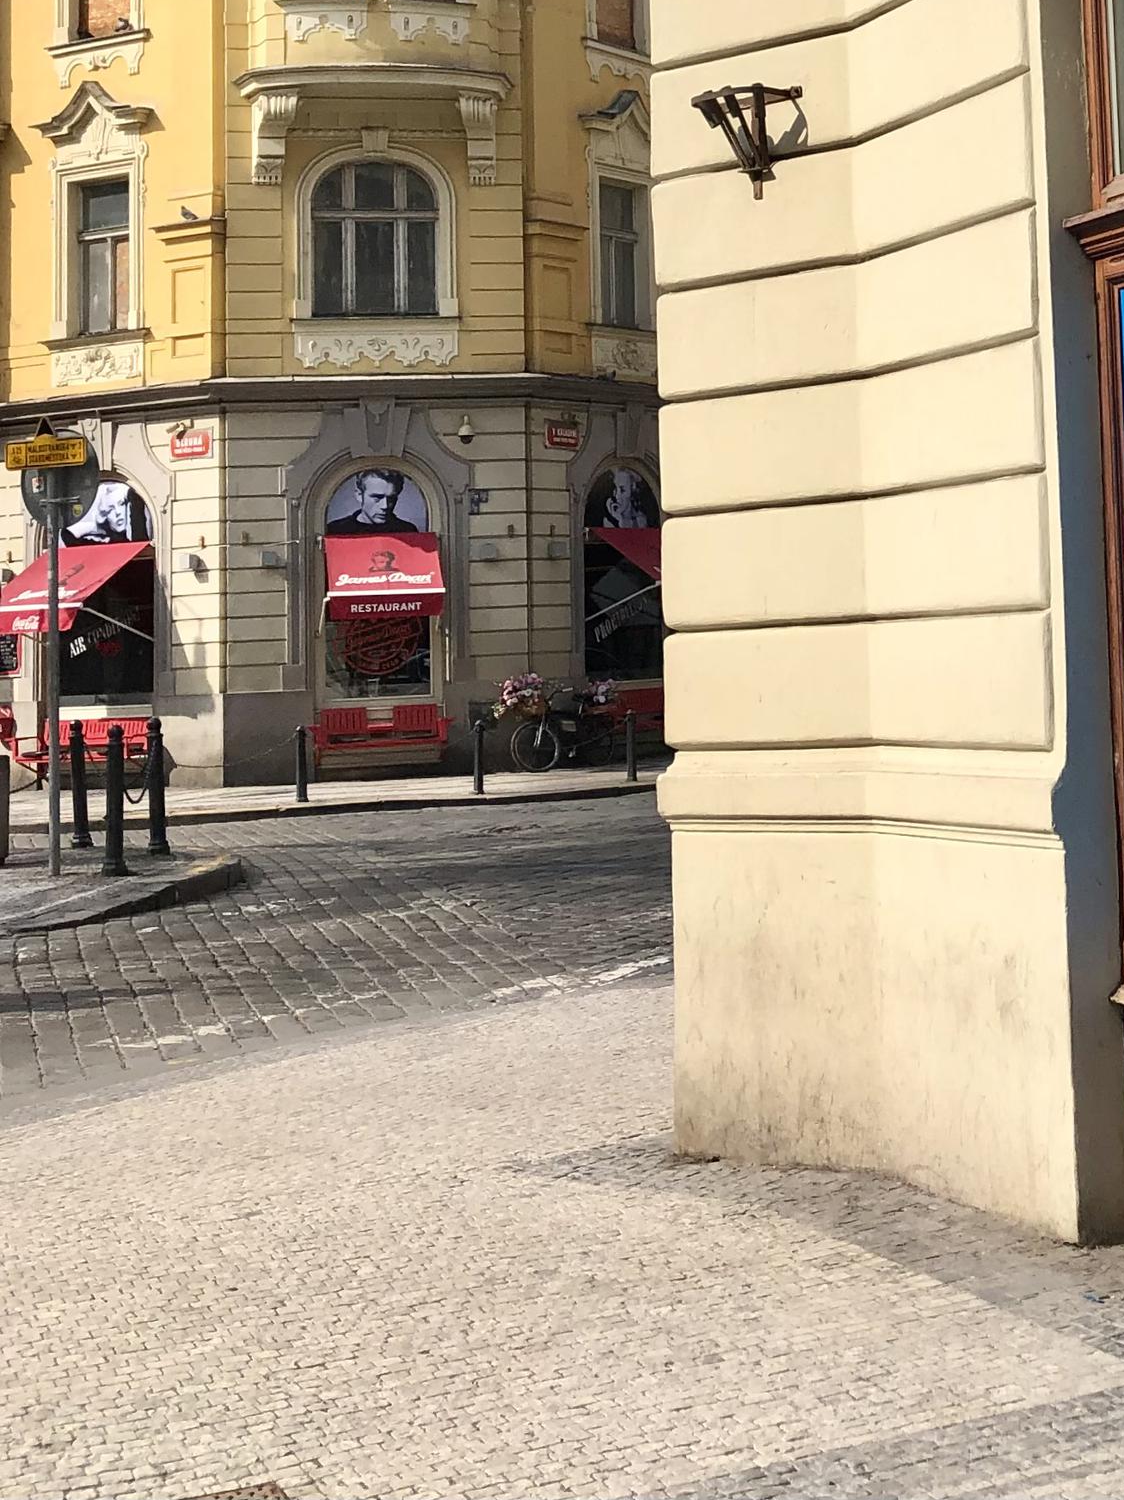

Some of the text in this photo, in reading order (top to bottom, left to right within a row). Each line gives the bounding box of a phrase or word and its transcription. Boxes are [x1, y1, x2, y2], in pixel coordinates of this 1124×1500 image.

[335, 572, 432, 587] James Dean
[350, 602, 422, 613] RESTAURANT
[69, 635, 87, 658] AIR
